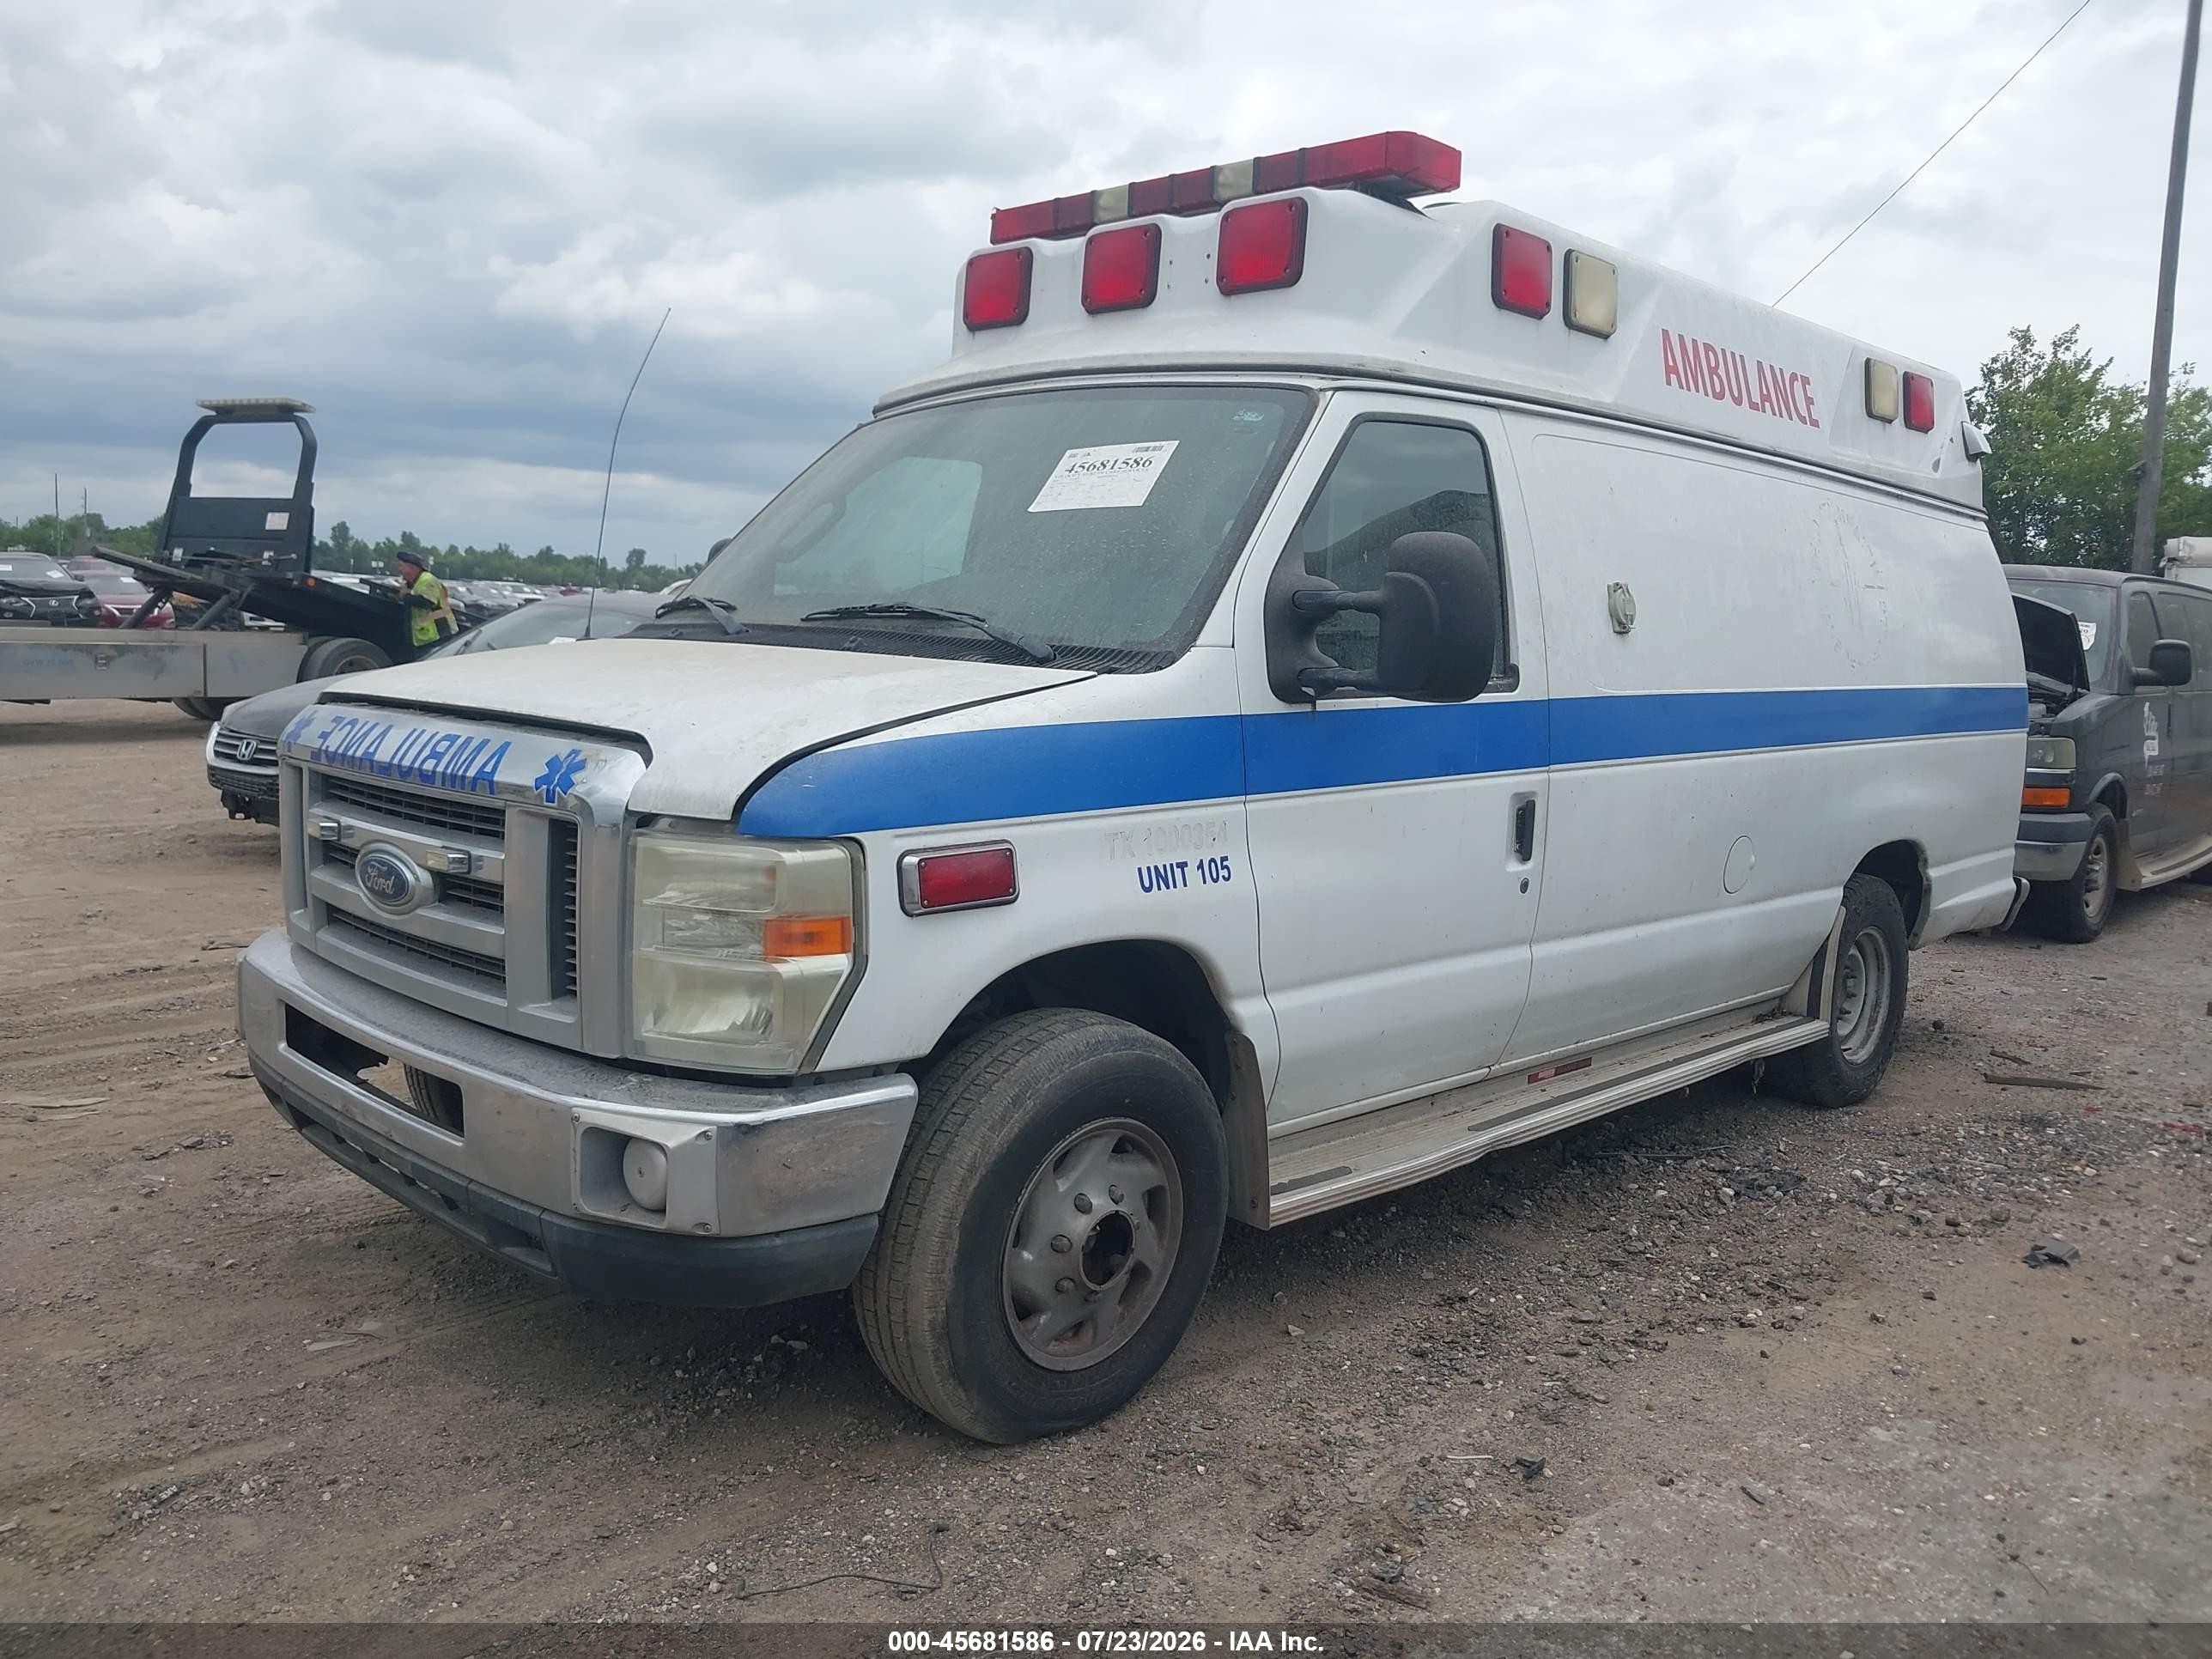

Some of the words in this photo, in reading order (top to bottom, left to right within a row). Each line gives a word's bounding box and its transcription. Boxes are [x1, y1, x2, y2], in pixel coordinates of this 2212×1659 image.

[1661, 328, 1820, 428] AMBULANCE
[1065, 455, 1155, 474] 45681586
[365, 860, 396, 895] Ford
[1137, 860, 1188, 894] UNIT
[1196, 855, 1232, 885] 105
